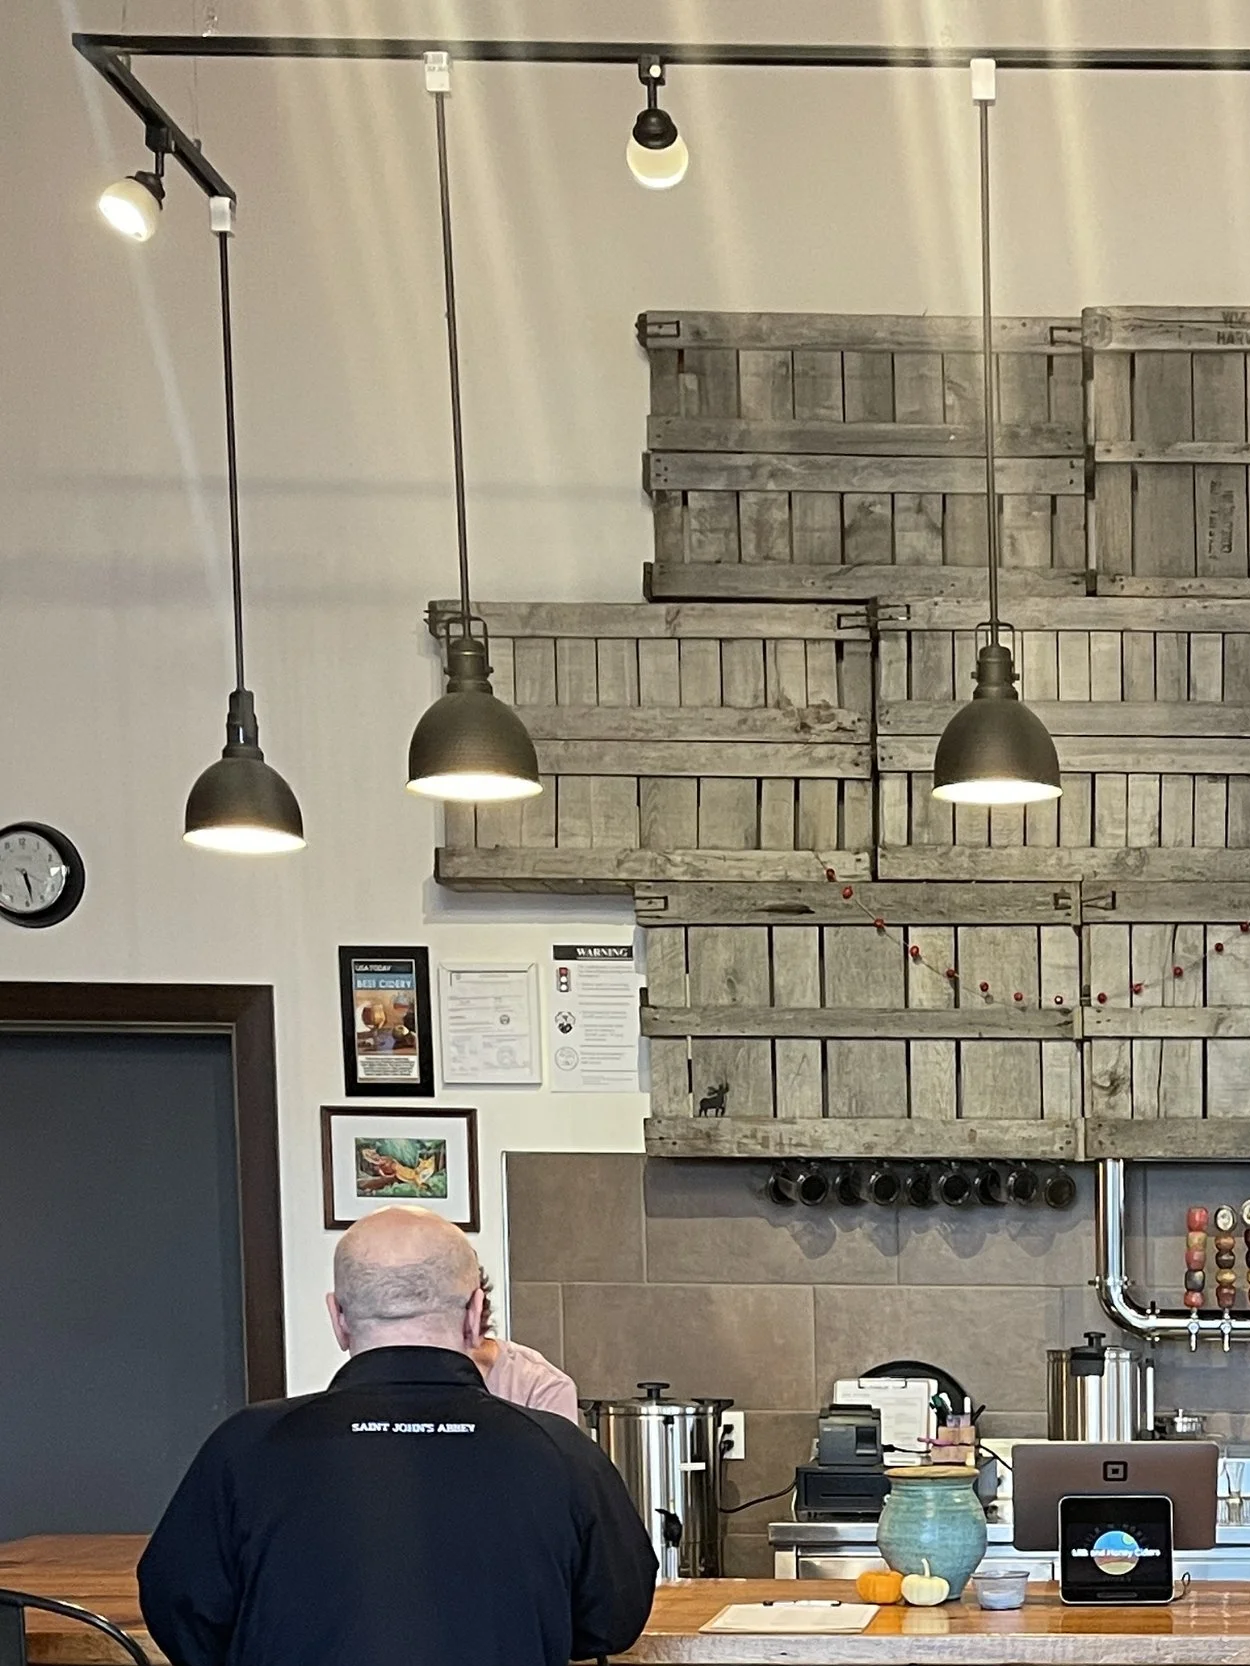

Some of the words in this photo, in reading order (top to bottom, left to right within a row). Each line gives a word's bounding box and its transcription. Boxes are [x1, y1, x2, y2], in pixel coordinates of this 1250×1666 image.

[576, 947, 628, 957] WARNING
[351, 1422, 390, 1432] SAINT
[392, 1423, 434, 1433] JOHN'S
[437, 1423, 475, 1433] ABBEY
